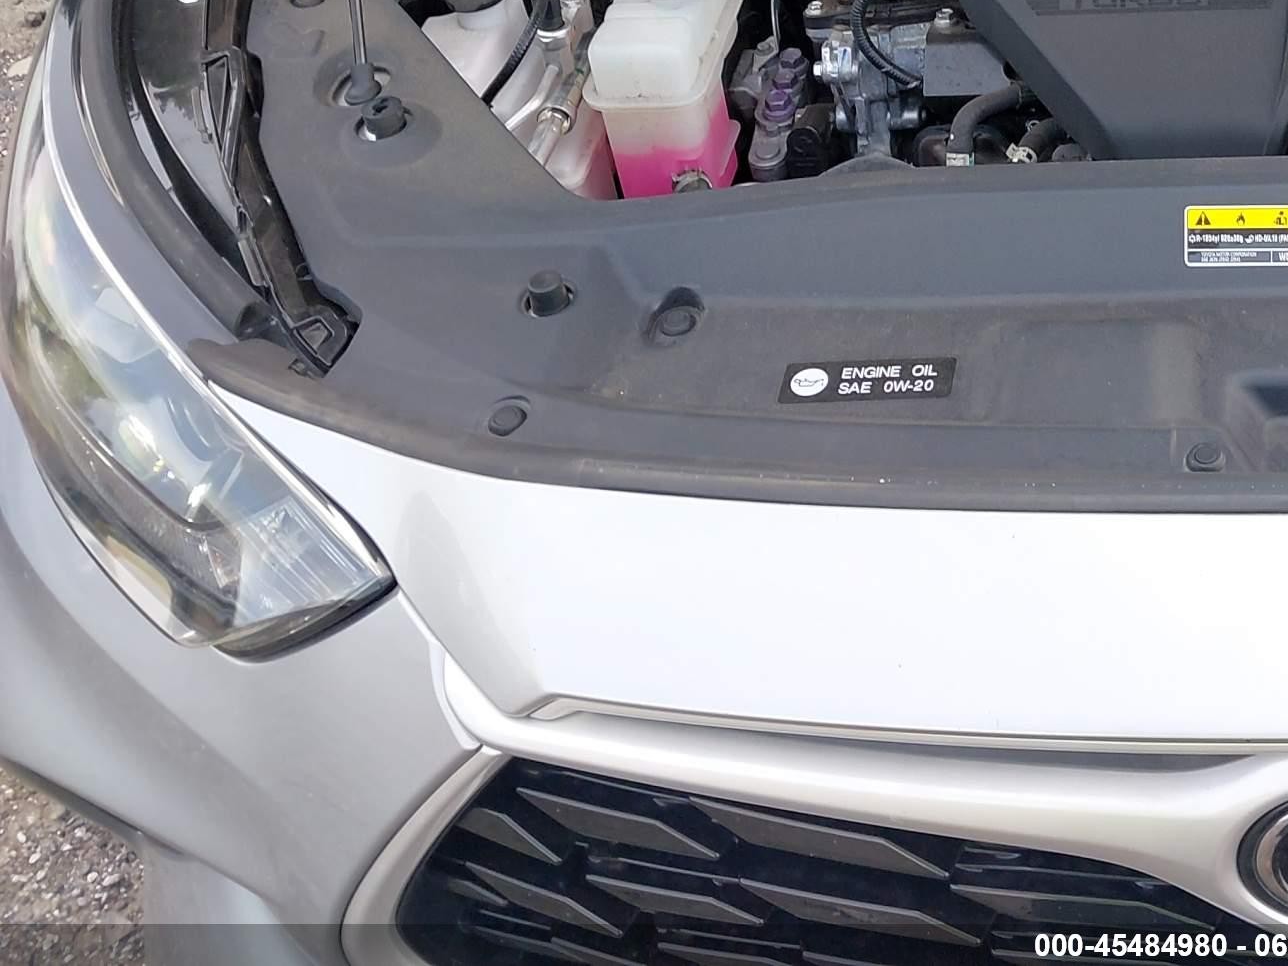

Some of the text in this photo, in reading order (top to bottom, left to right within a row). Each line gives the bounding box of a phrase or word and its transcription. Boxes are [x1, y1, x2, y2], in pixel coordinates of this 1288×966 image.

[841, 364, 938, 380] ENGINE OIL
[838, 379, 934, 395] SAE 0W-20
